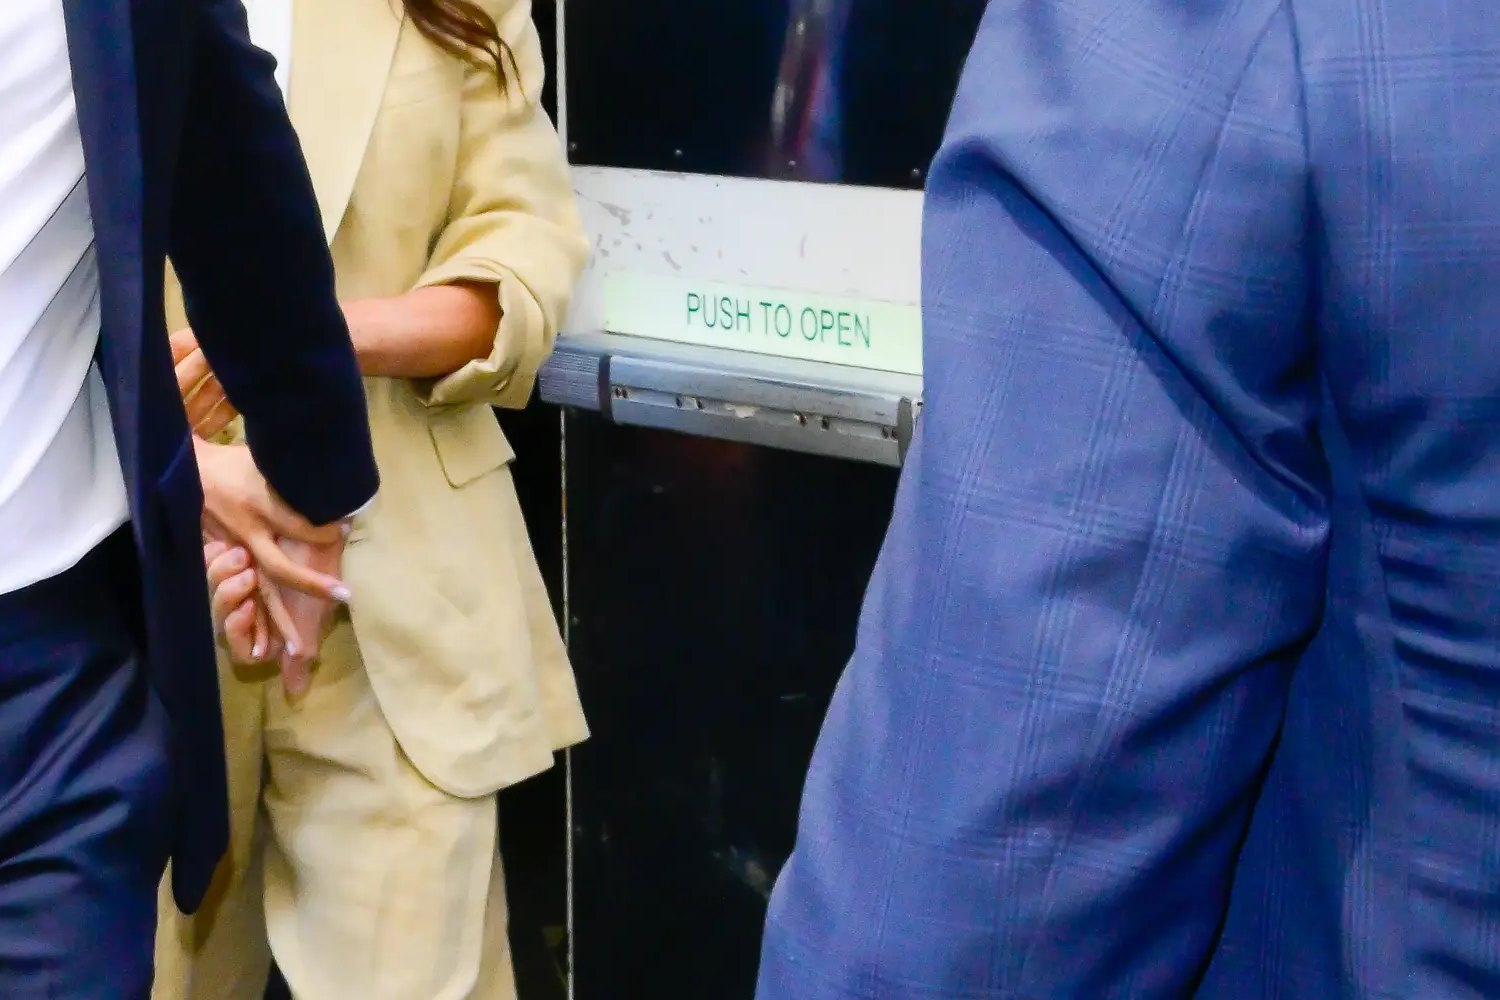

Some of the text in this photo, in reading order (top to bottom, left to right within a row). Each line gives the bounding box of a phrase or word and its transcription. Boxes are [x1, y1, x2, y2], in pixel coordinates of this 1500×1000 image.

[686, 292, 871, 348] PUSH TO OPEN
